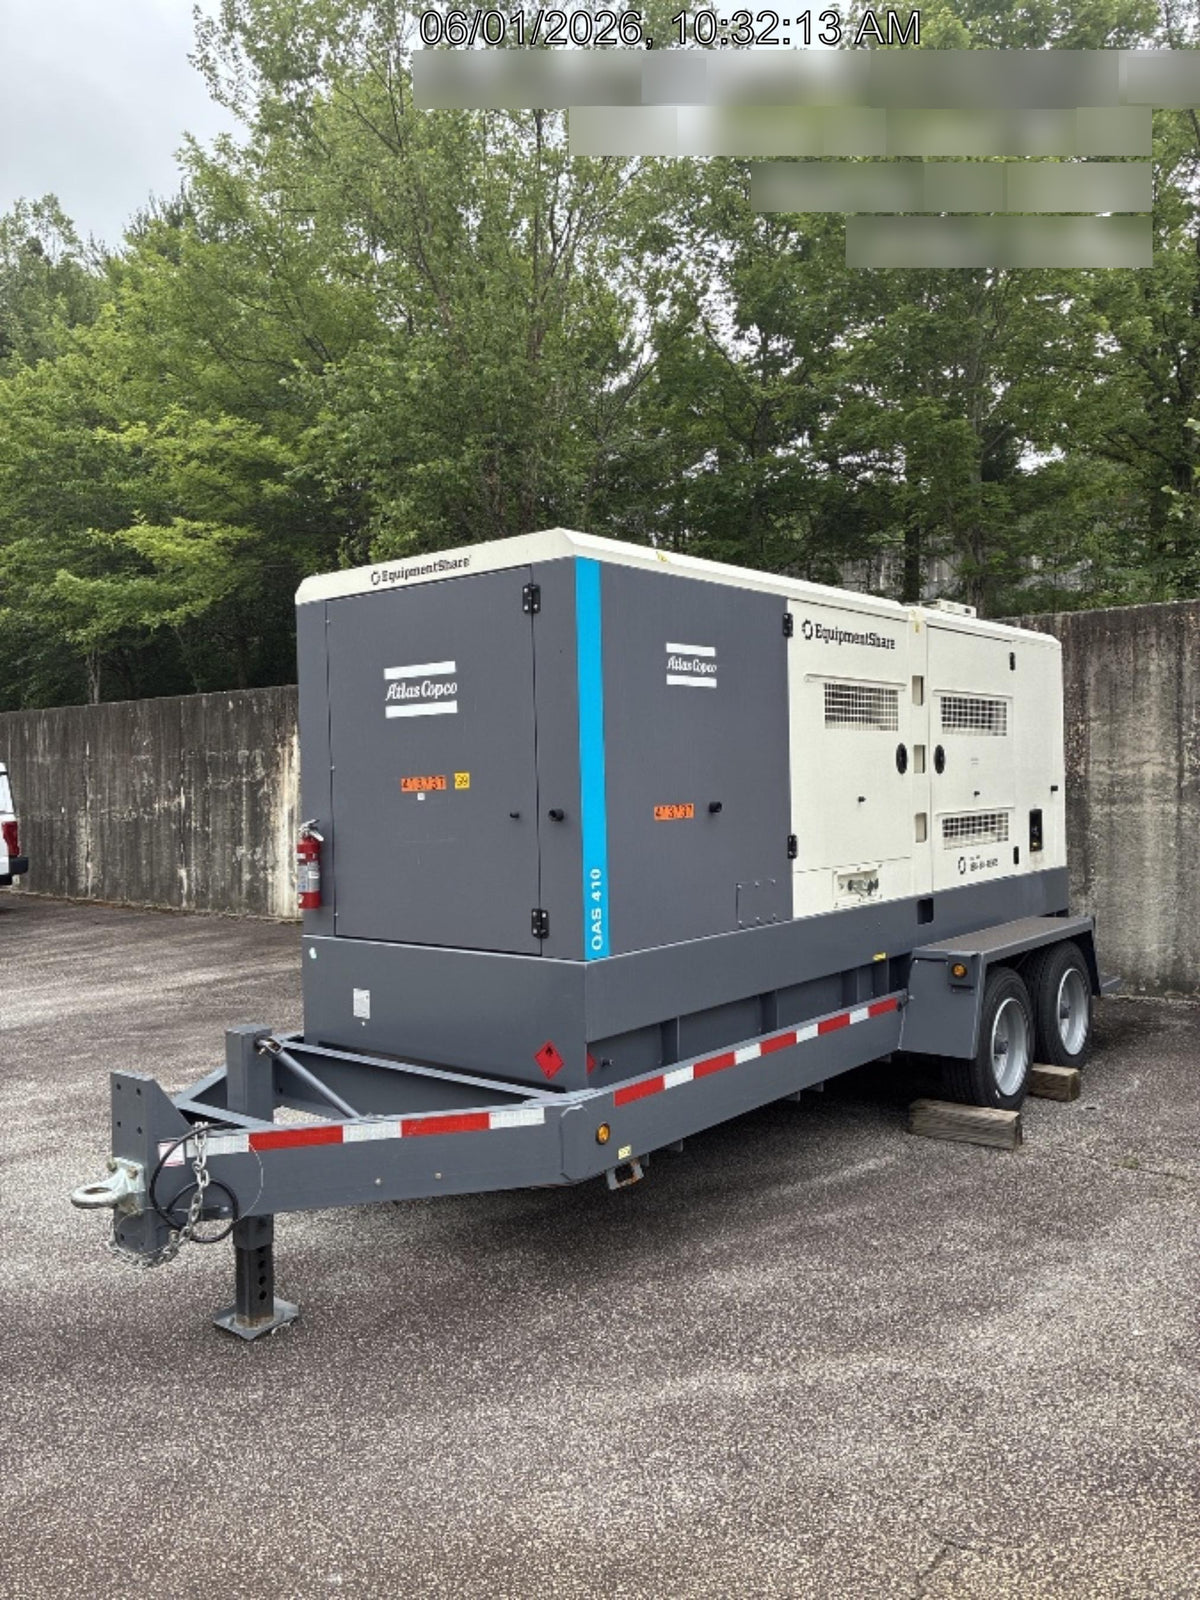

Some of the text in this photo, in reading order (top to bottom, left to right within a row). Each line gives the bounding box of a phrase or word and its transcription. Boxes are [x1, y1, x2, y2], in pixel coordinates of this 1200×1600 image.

[382, 557, 470, 583] EquipmentShare
[815, 623, 896, 650] EquipmentShare
[666, 655, 718, 674] Atlas Copco
[385, 680, 458, 701] Atlas Copco
[590, 868, 602, 902] 410
